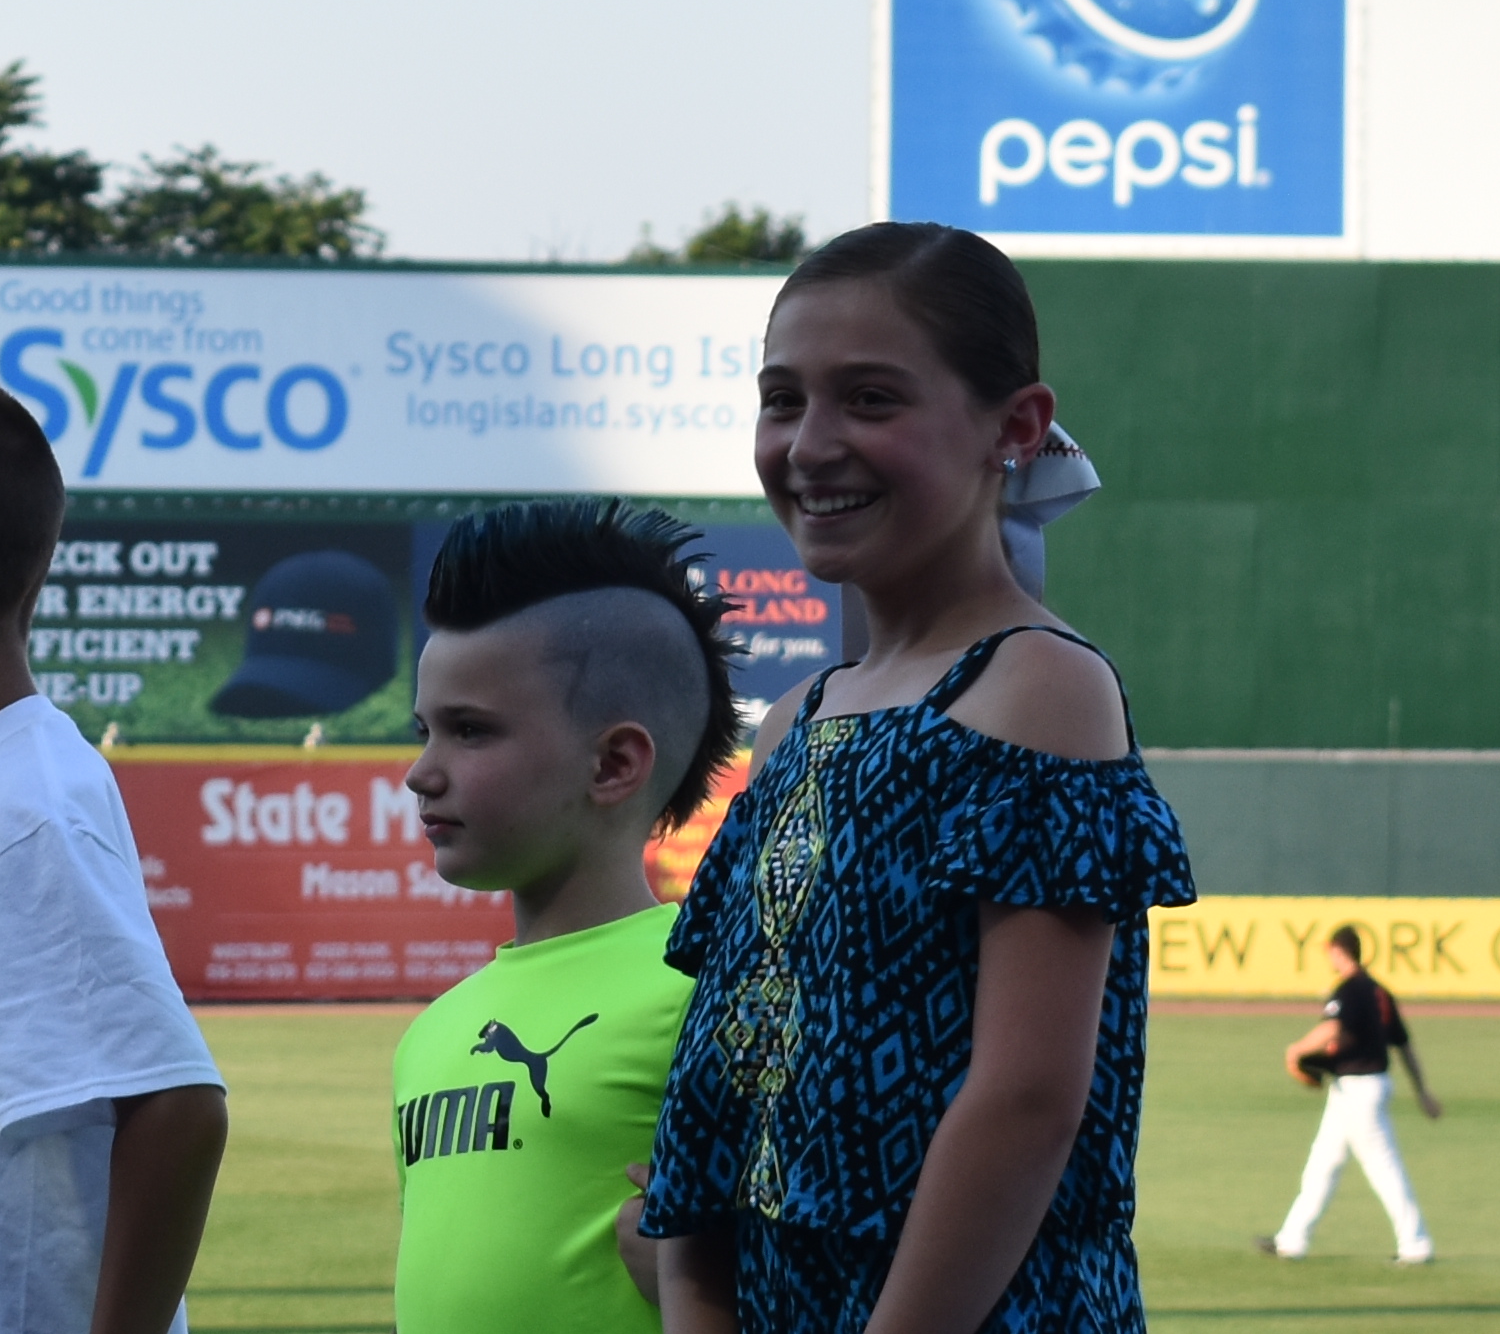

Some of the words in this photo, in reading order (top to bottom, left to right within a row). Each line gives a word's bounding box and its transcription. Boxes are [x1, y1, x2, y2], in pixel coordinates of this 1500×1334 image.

[978, 103, 1261, 208] pepsi
[0, 279, 91, 315] Good
[99, 280, 208, 323] things
[81, 325, 176, 355] come
[181, 322, 265, 355] from
[385, 330, 532, 385] Sysco
[550, 334, 676, 388] Long
[128, 540, 219, 576] OUT
[716, 569, 808, 595] LONG
[76, 585, 246, 619] ENERGY
[29, 628, 201, 663] FICIENT
[201, 776, 352, 846] State
[301, 862, 399, 900] Mason
